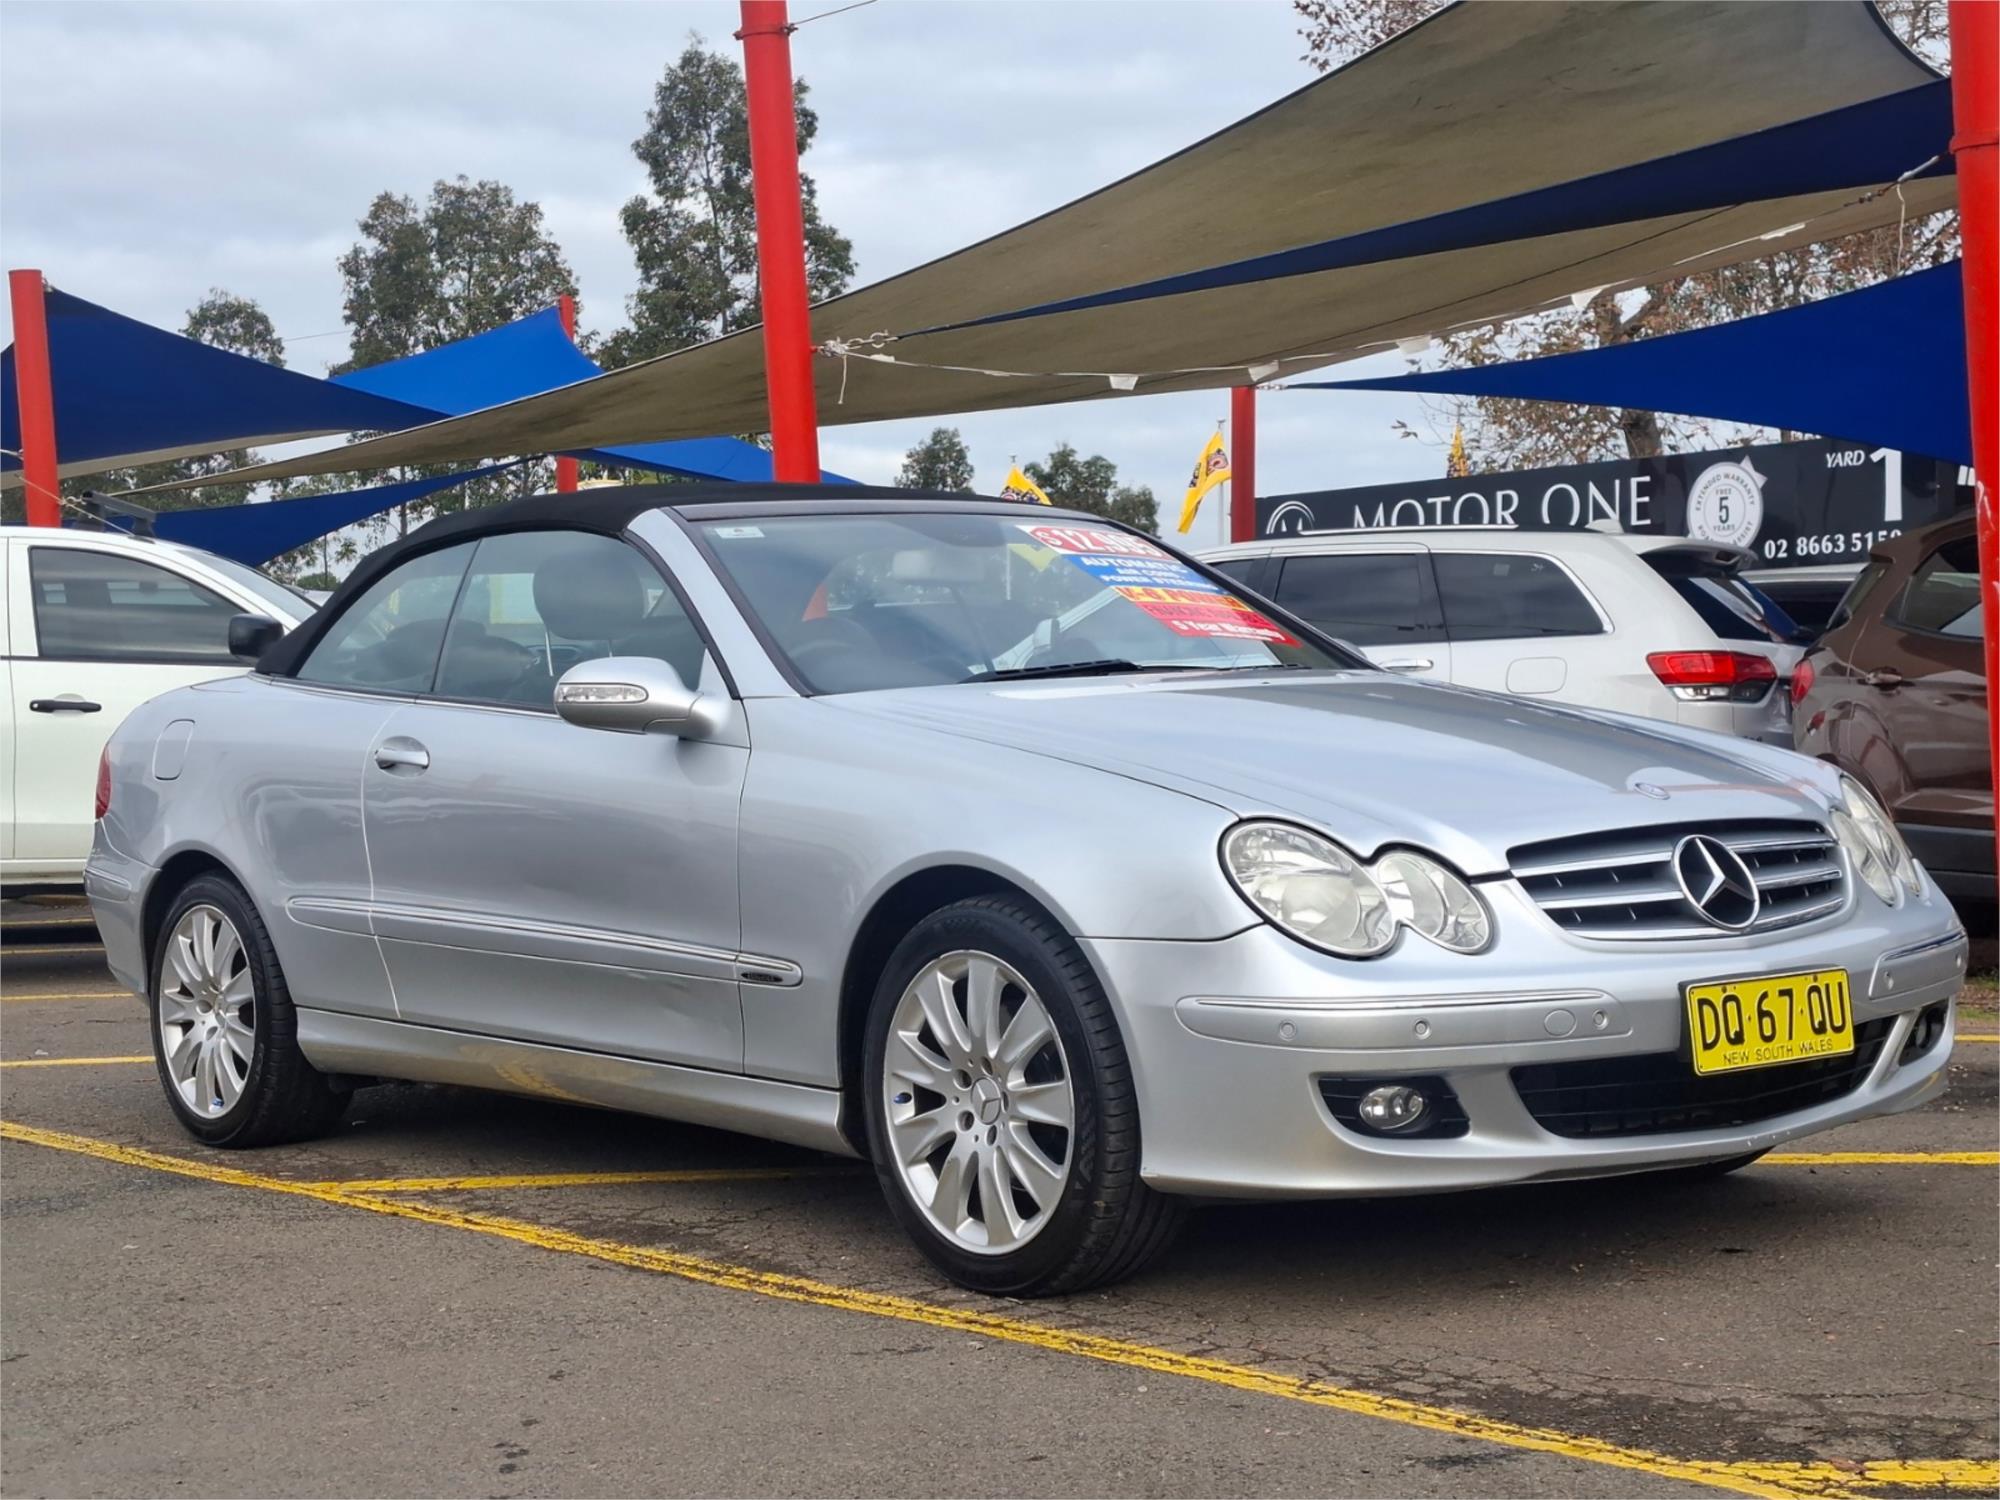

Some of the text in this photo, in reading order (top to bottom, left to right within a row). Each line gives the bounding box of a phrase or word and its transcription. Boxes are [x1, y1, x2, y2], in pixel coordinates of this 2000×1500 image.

[1695, 473, 1755, 512] EXTENDED WARRANTY
[1826, 447, 1903, 521] YARD 1
[1353, 475, 1651, 528] MOTOR ONE
[1718, 496, 1730, 524] 5
[1713, 524, 1735, 532] YEARS
[1764, 538, 1788, 559] 02
[1796, 533, 1845, 556] 8663
[1697, 981, 1847, 1052] DQ 67 QU
[1723, 1038, 1833, 1065] NEW SOUTH WALES
